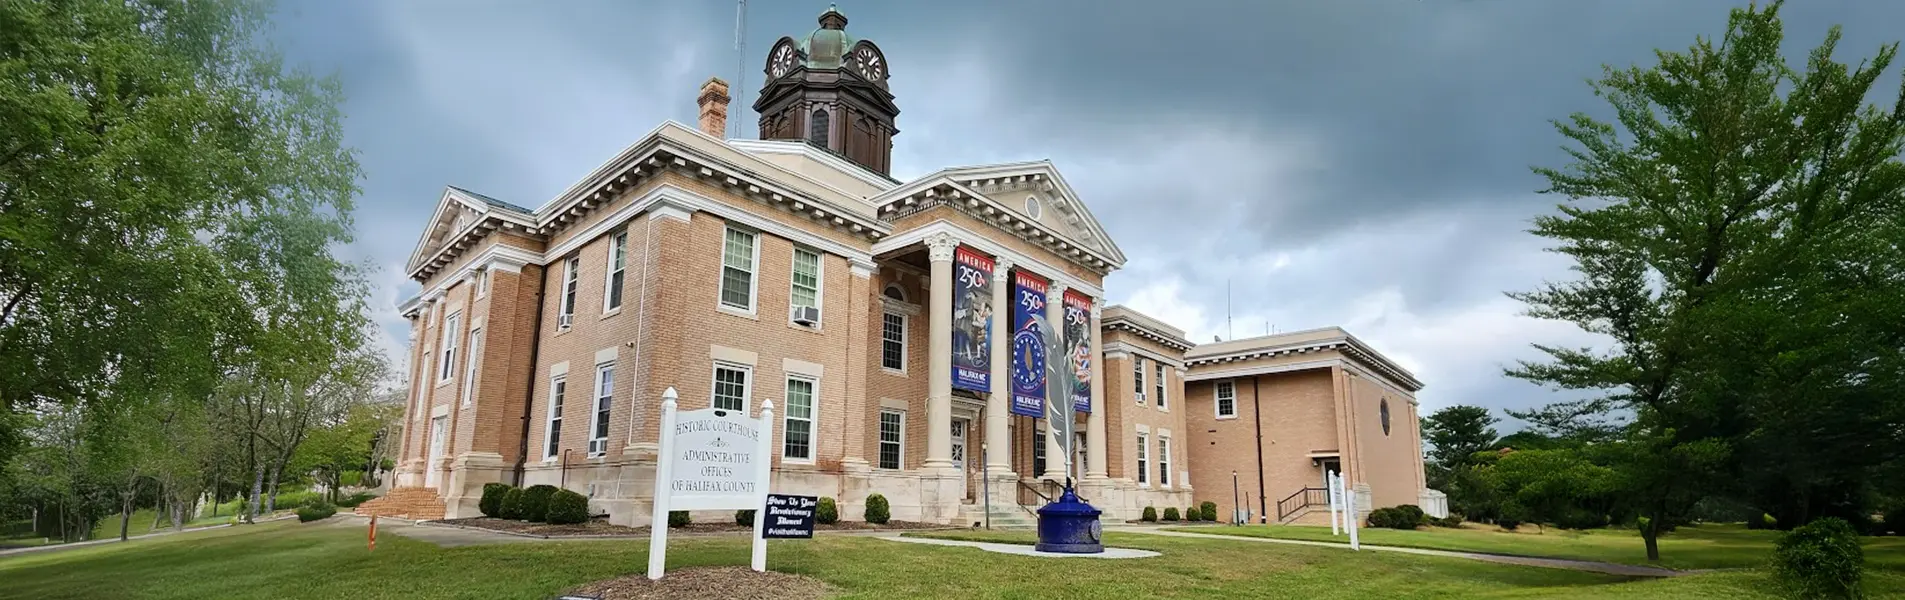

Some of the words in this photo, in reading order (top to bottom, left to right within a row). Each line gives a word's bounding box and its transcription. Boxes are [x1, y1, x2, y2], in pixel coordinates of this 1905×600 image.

[959, 253, 991, 272] AMERICA
[1017, 276, 1045, 294] AMERICA
[1066, 295, 1090, 311] AMERICA
[675, 419, 711, 435] HISTORIC
[712, 419, 759, 441] COURTHOUSE
[682, 449, 750, 464] ADMINISTRATIVE
[701, 466, 732, 478] OFFICES
[671, 479, 684, 491] OF
[685, 480, 721, 492] HALIFAX
[723, 481, 755, 493] COUNTY
[767, 496, 786, 505] Show
[788, 497, 799, 506] Us
[800, 497, 816, 508] Your
[769, 506, 812, 518] Revolutionary
[776, 516, 803, 525] Moment
